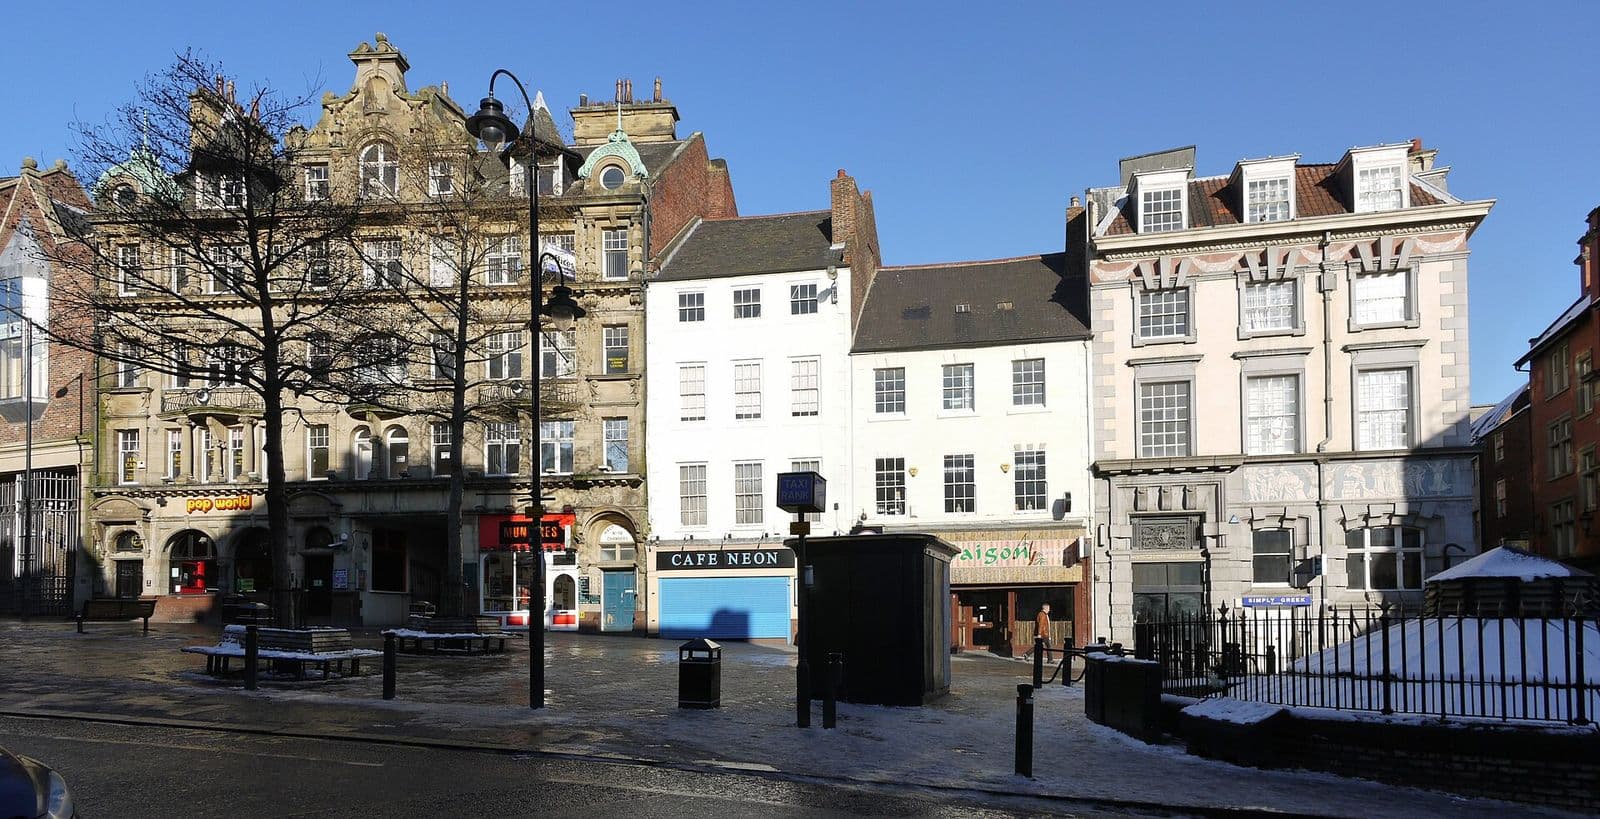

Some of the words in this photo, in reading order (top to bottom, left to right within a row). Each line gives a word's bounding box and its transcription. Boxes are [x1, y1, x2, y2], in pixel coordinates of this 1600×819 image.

[783, 479, 808, 489] TAXI
[783, 491, 809, 503] RANK
[187, 499, 214, 514] pop
[215, 495, 252, 510] world
[671, 553, 718, 566] CAFE
[727, 552, 778, 565] NEON
[953, 543, 1028, 565] aigon
